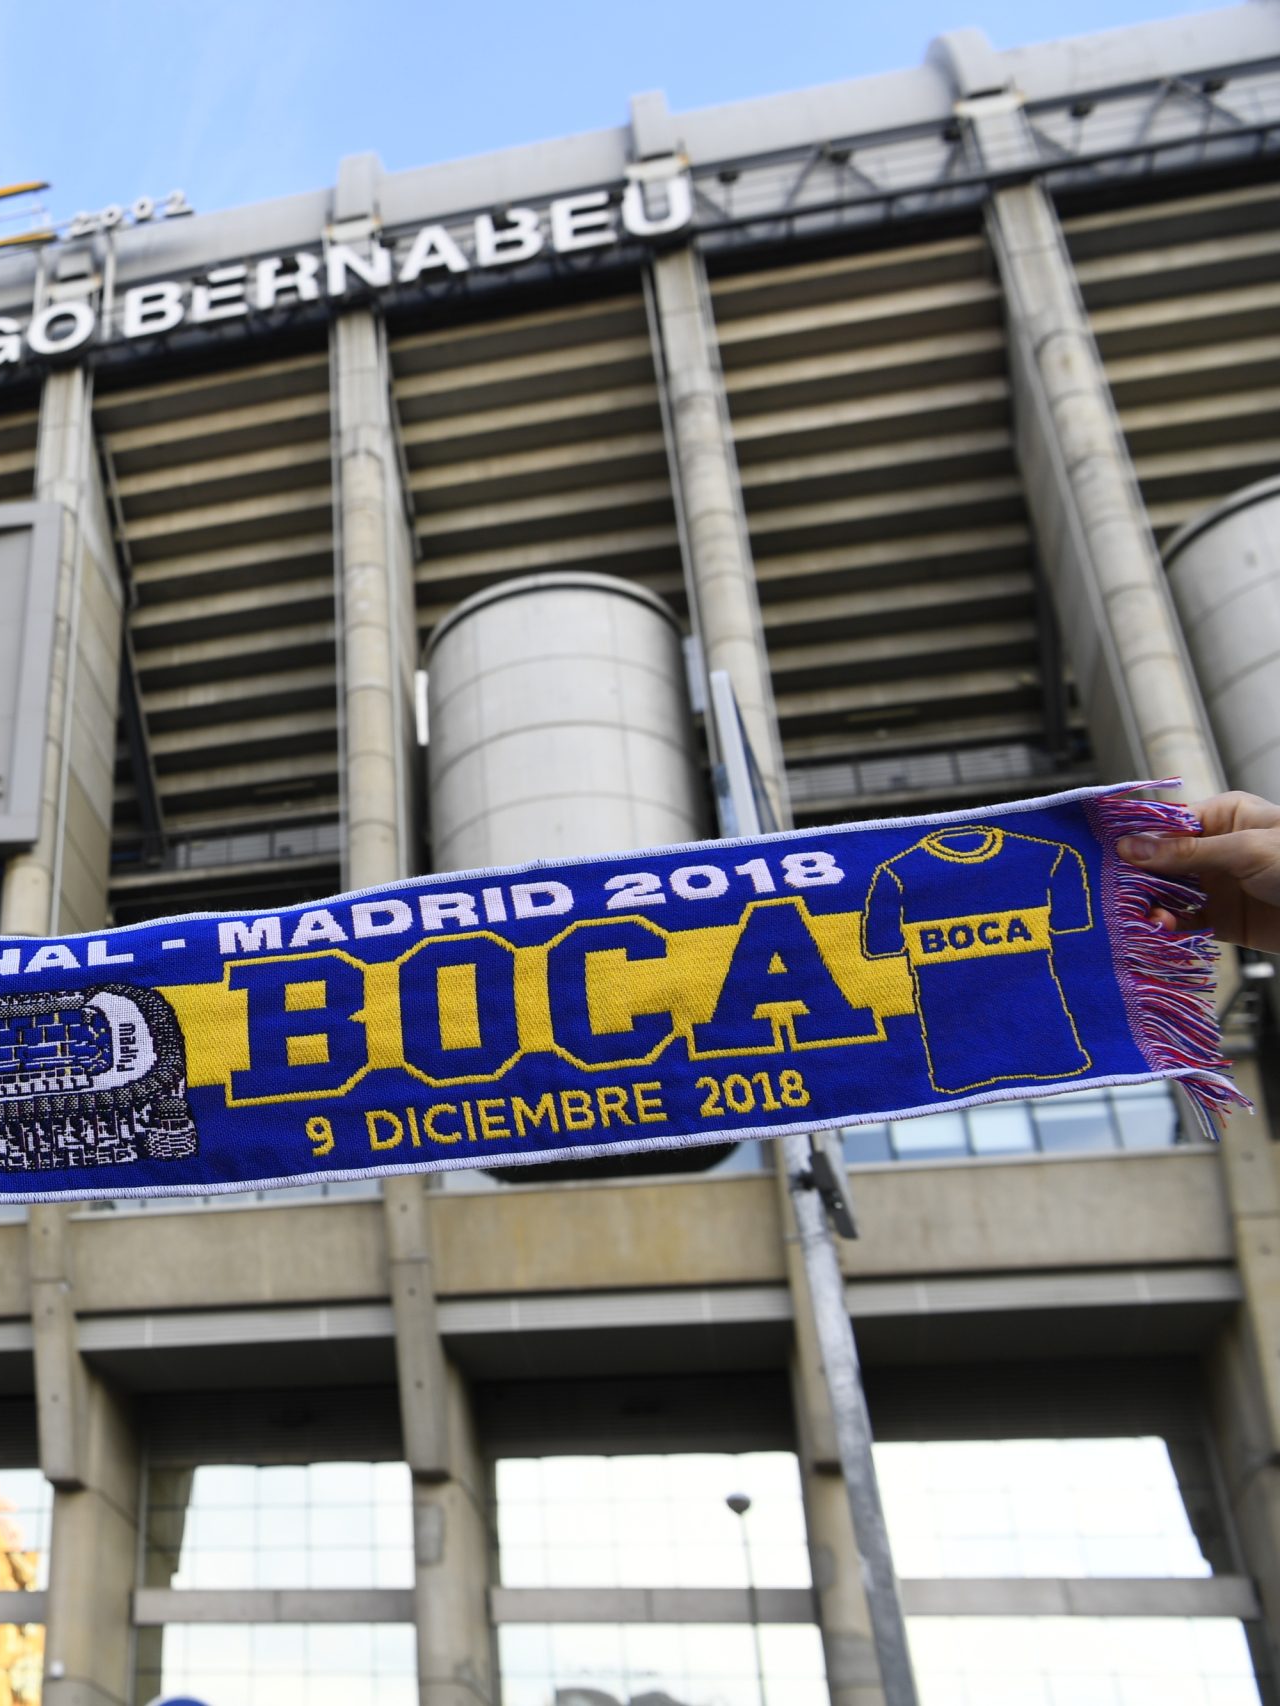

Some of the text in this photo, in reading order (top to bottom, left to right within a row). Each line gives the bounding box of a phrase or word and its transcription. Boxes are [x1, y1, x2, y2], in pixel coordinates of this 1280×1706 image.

[123, 176, 695, 338] BERNABEU
[220, 880, 574, 953] MADRID
[605, 851, 845, 910] 2018
[921, 917, 1031, 954] BOCA
[223, 896, 886, 1107] BOCA
[305, 1070, 810, 1156] 9 DICIEMBRE 2018
